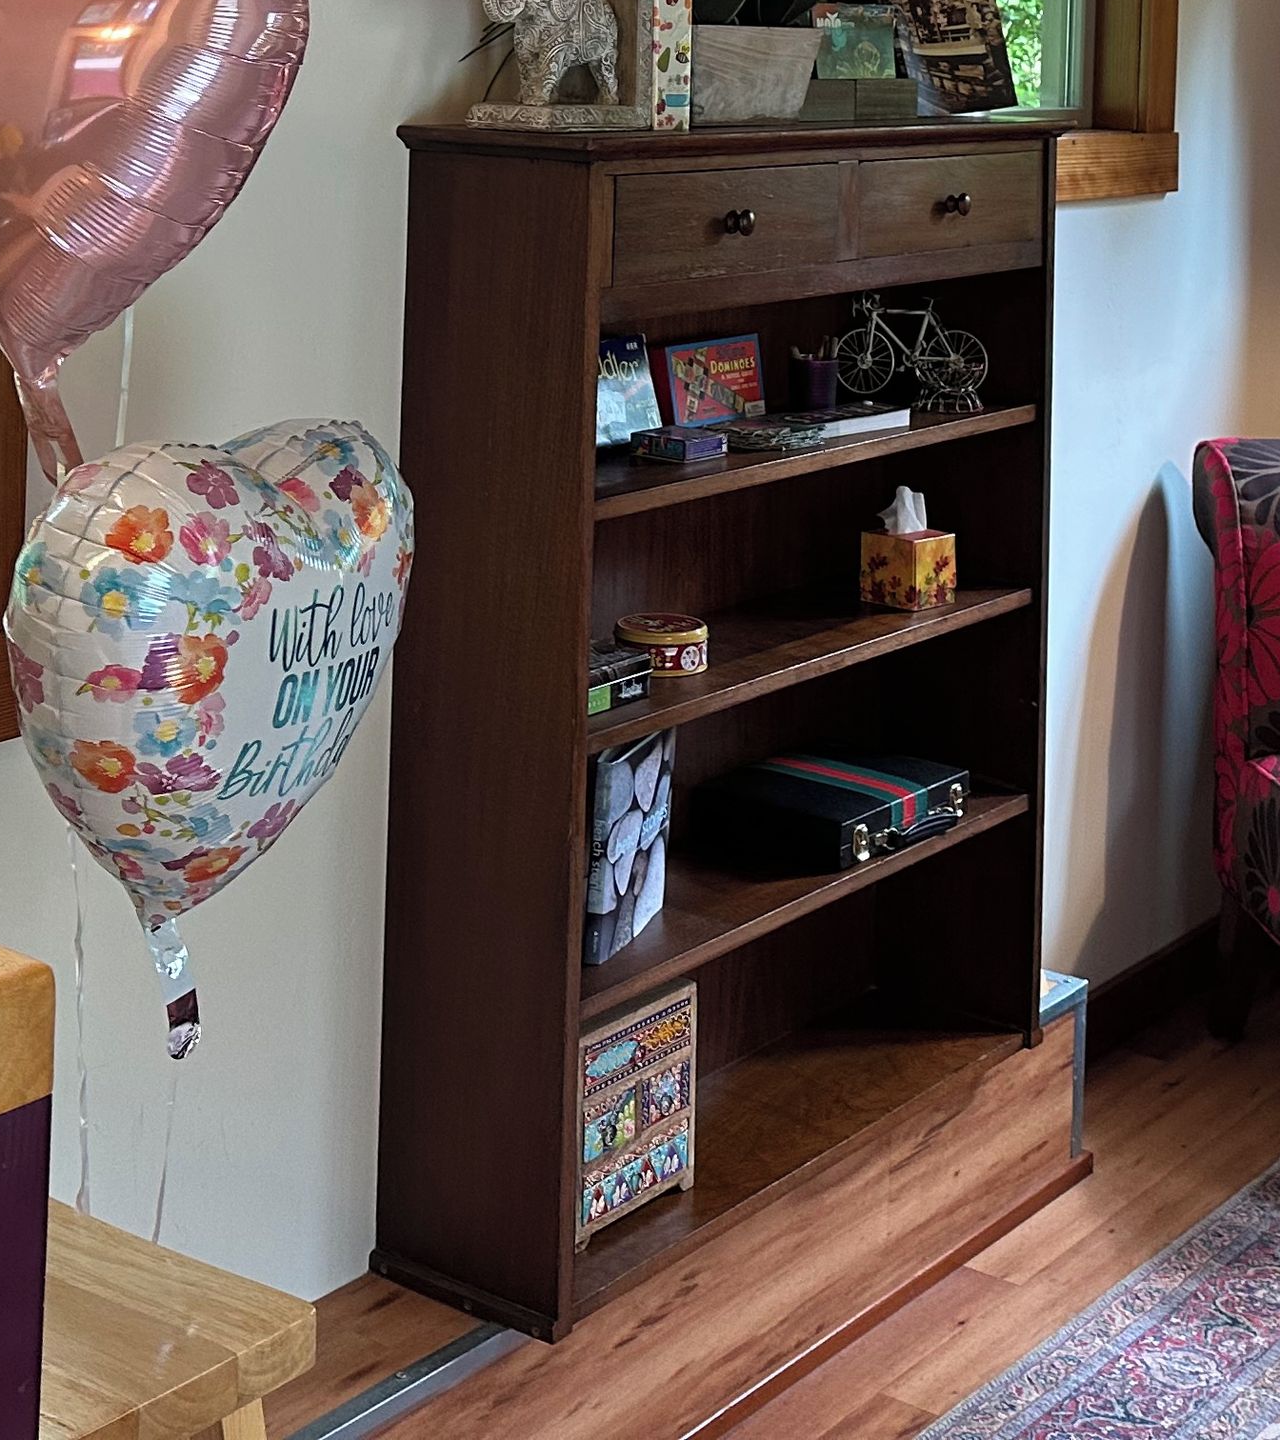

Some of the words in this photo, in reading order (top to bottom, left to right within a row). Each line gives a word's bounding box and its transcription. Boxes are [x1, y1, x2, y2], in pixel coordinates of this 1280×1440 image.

[710, 356, 755, 374] DOMINOES
[270, 584, 344, 672] With
[350, 582, 394, 648] love
[272, 669, 320, 729] ON
[322, 646, 380, 717] YOUR
